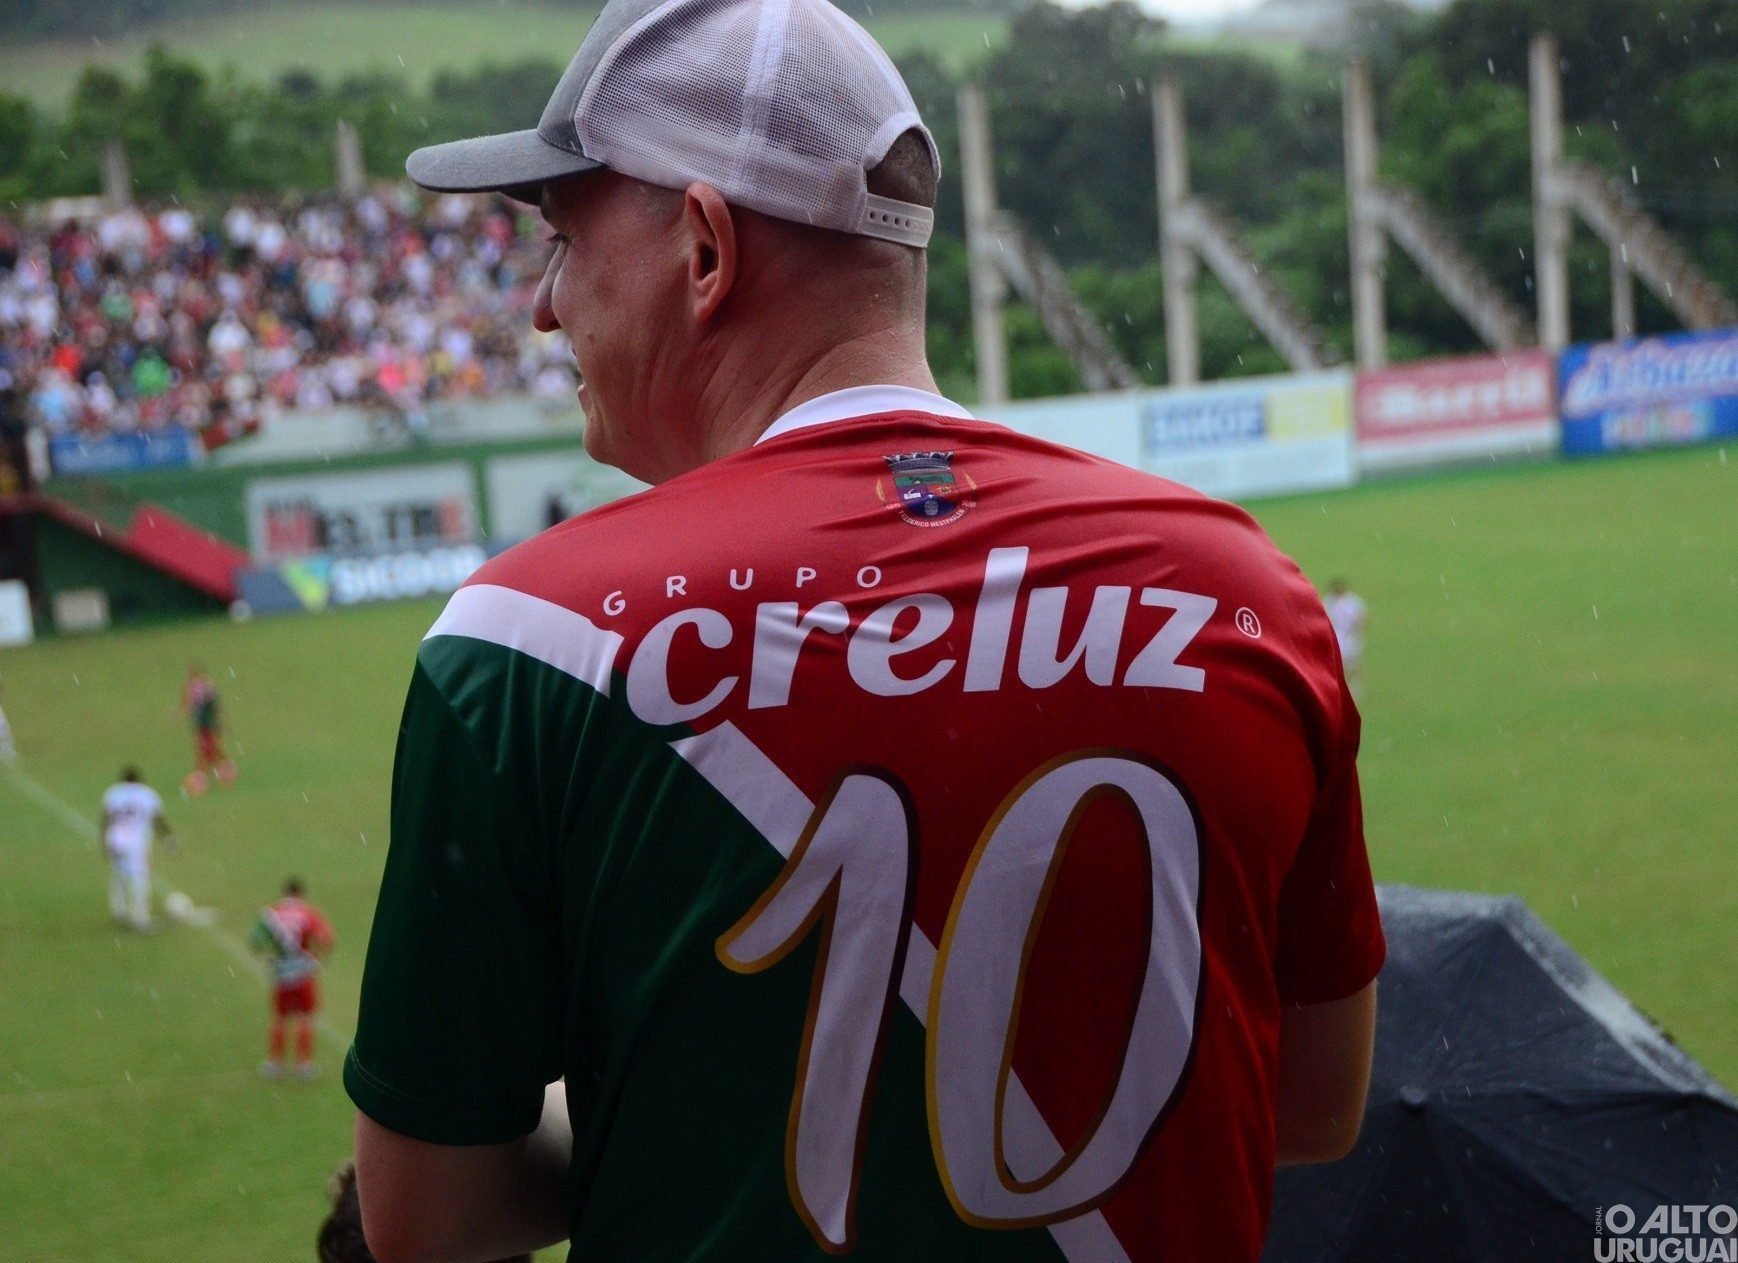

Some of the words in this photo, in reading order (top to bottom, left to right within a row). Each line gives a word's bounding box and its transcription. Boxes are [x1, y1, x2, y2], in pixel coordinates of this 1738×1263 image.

[602, 565, 883, 616] GRUPO
[625, 546, 1218, 727] creluz
[714, 746, 1205, 1256] 10
